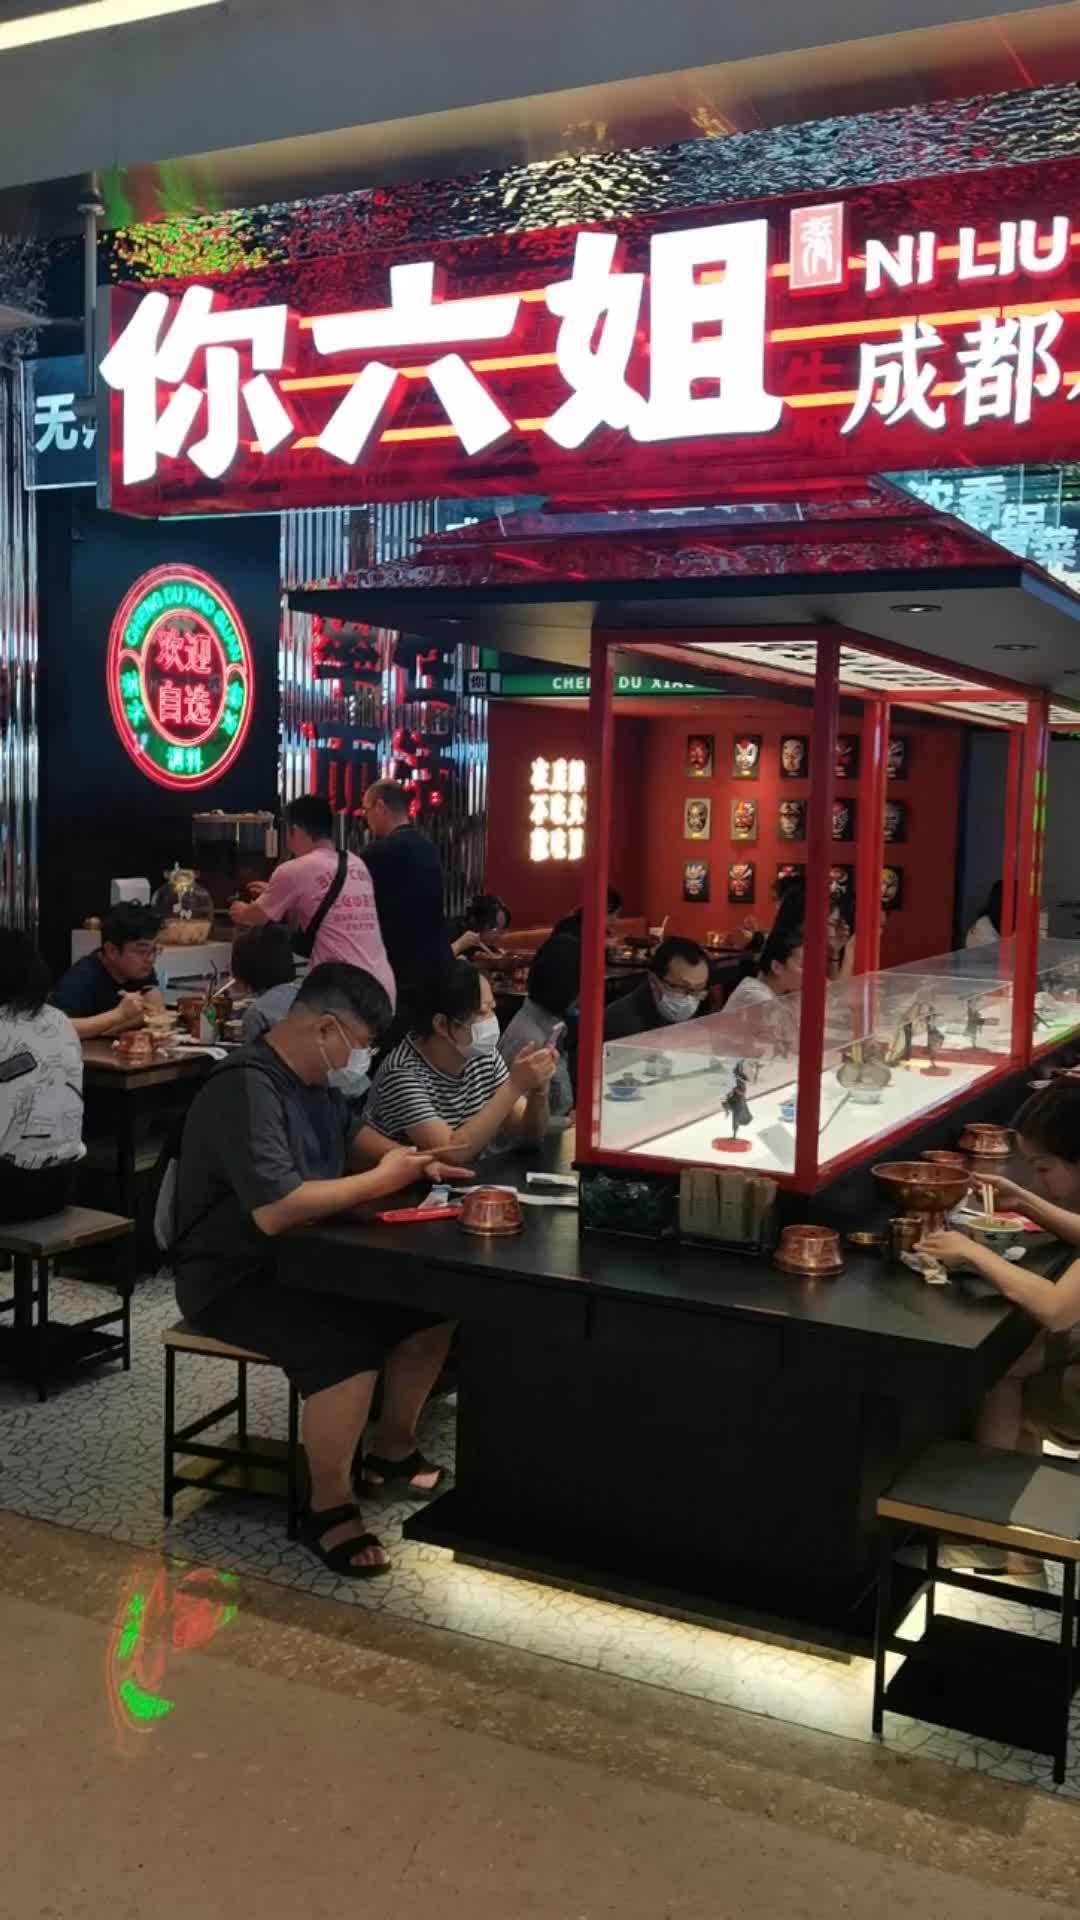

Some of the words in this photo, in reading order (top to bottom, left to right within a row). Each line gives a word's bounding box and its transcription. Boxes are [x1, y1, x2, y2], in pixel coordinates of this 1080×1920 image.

[864, 231, 936, 292] NI
[957, 215, 1071, 280] LIU
[99, 219, 784, 486] 你六姐
[840, 310, 1080, 434] 成都
[155, 627, 212, 674] 欢迎
[158, 679, 212, 726] 自选
[619, 676, 642, 689] DU
